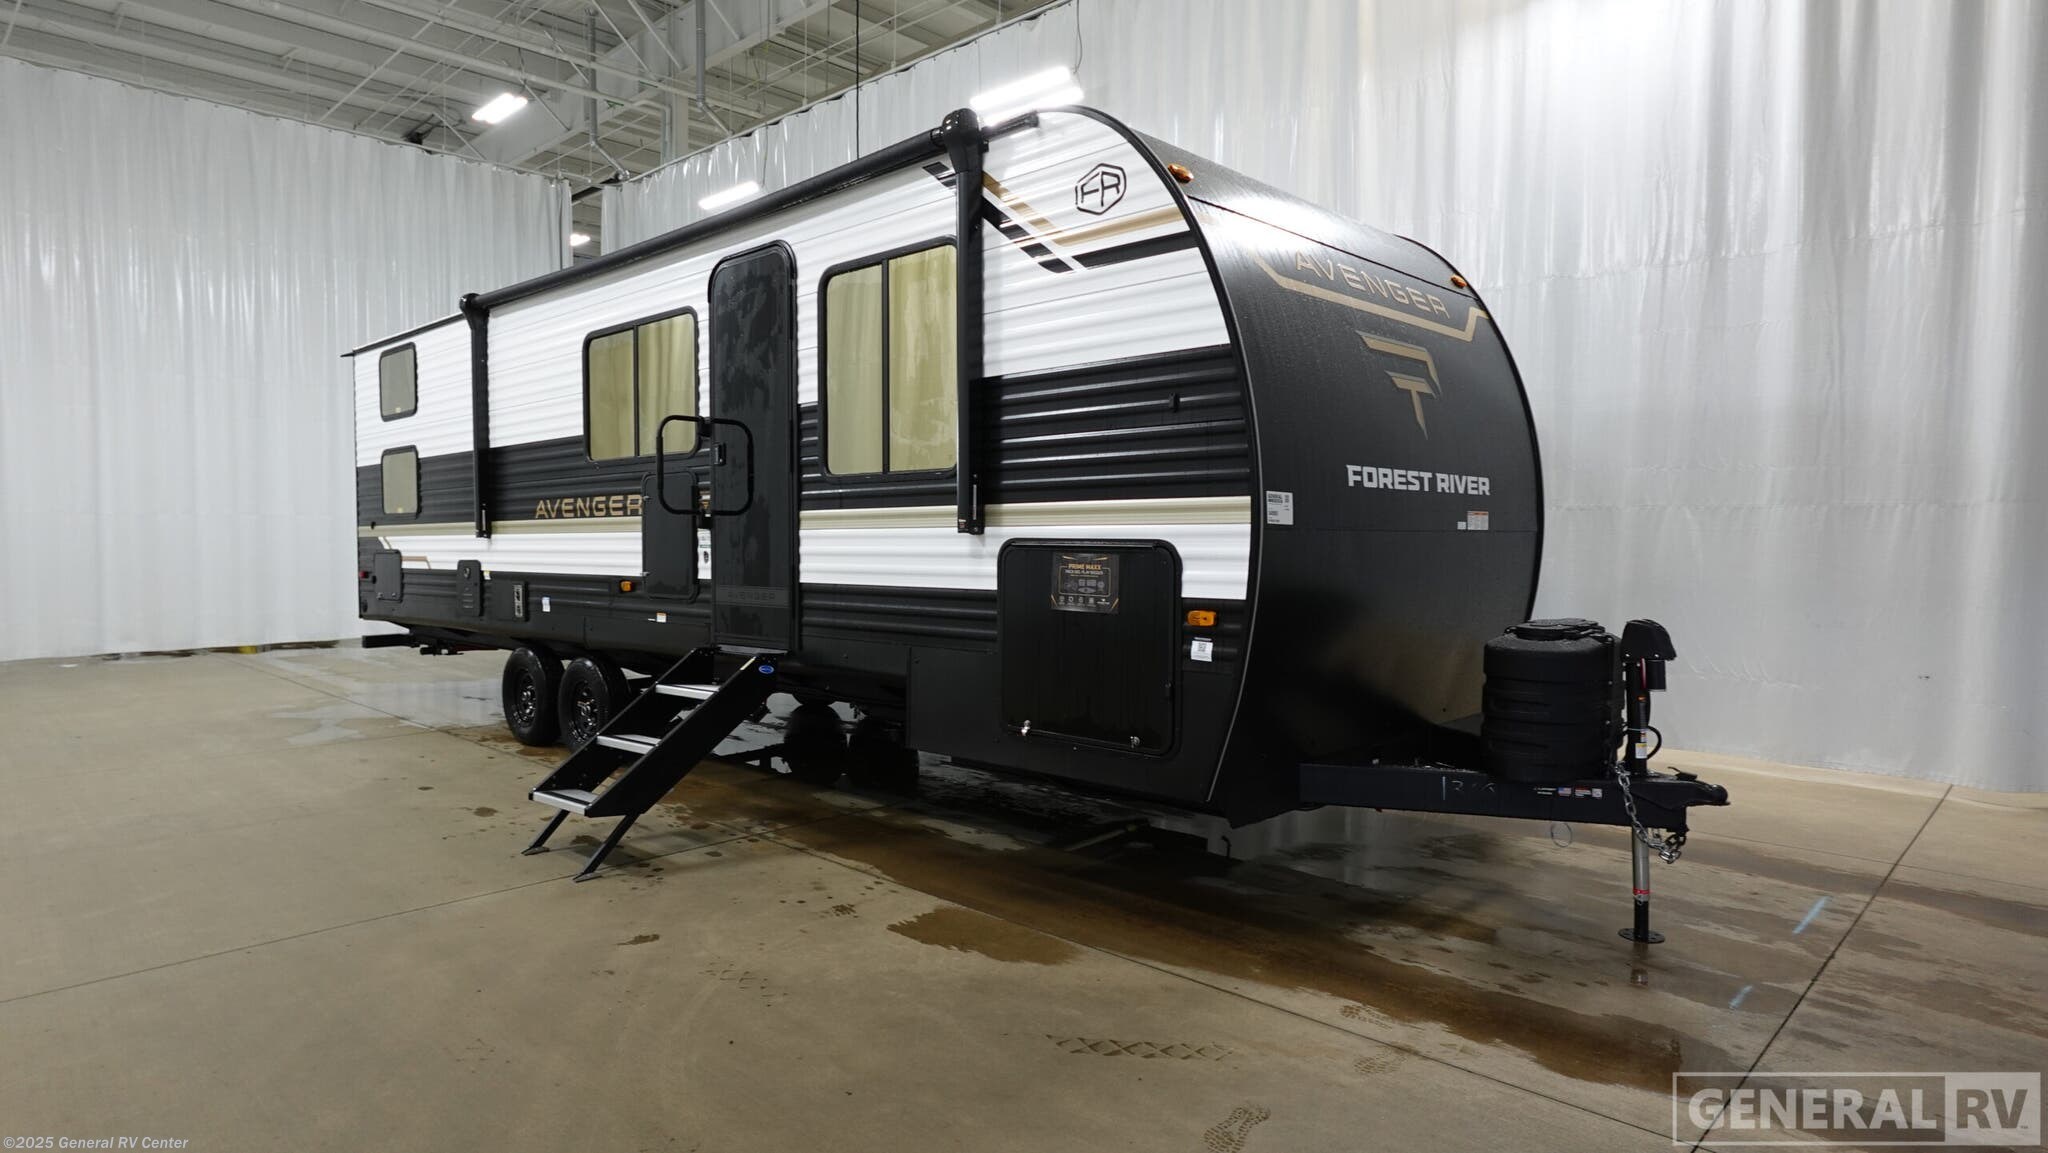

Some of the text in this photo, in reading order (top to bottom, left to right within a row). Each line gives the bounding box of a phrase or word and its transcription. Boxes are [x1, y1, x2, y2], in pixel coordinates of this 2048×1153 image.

[1296, 250, 1450, 319] AVENGER
[1346, 464, 1491, 496] FOREST RIVER
[535, 494, 642, 519] AVENGER
